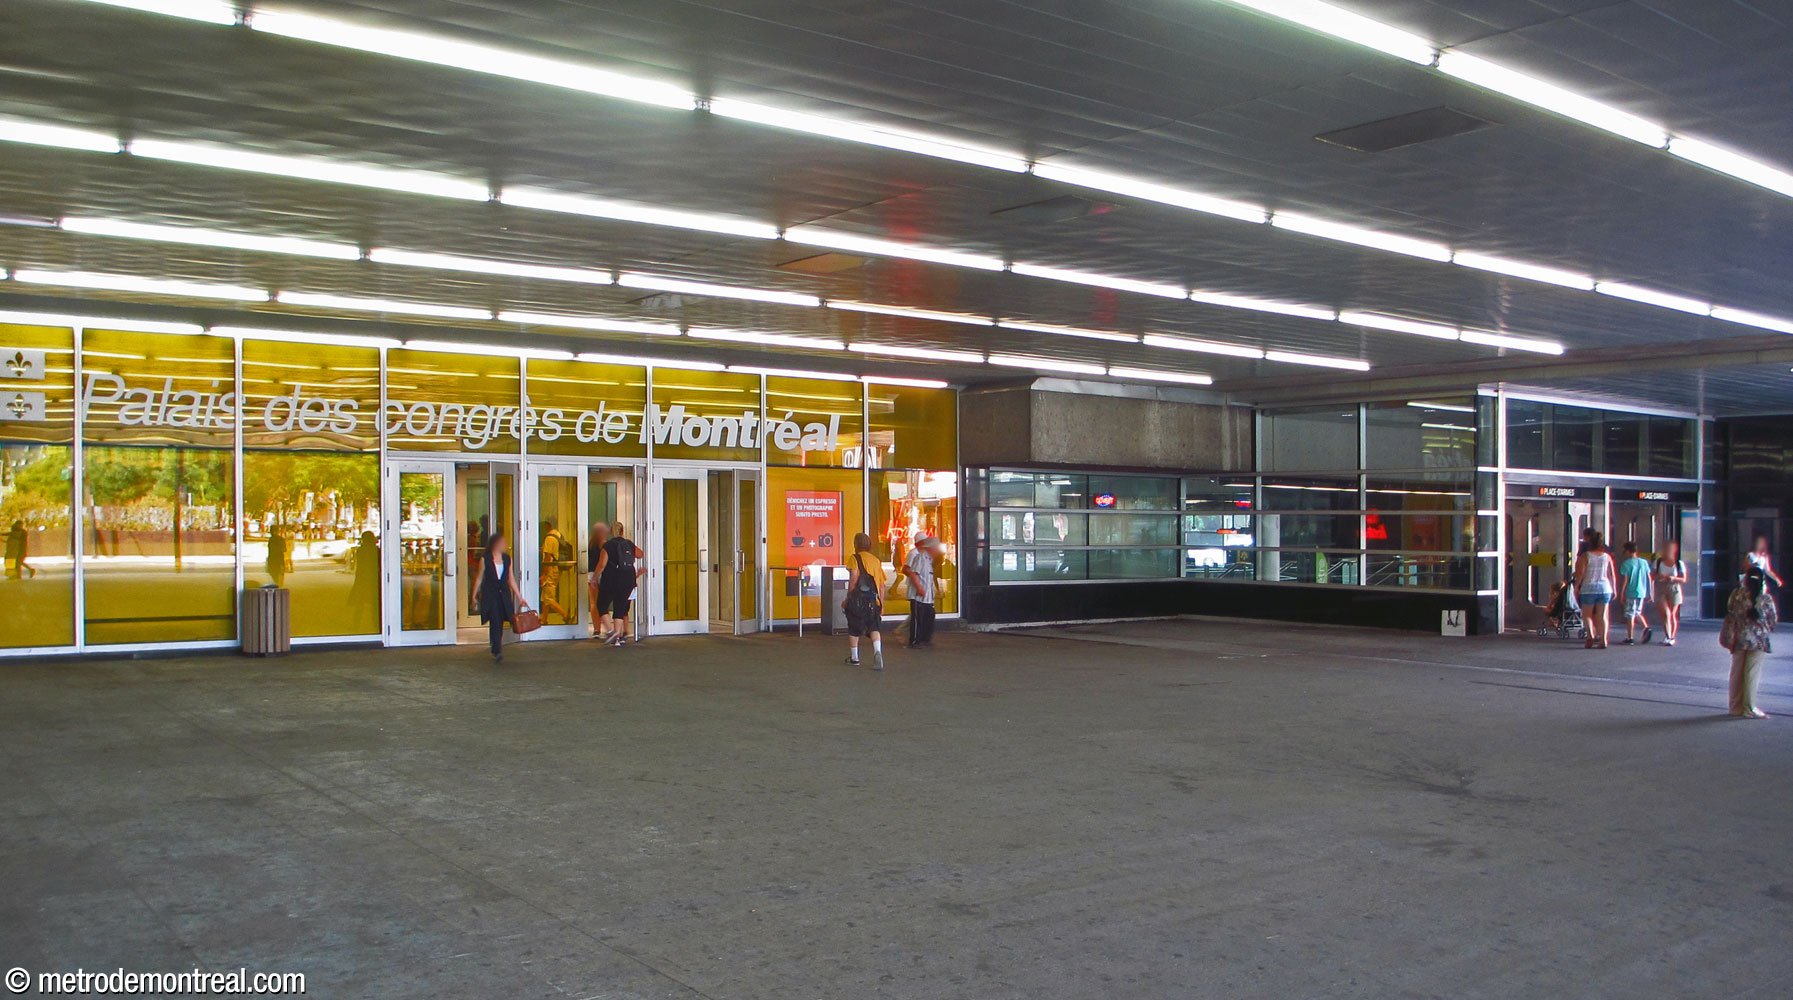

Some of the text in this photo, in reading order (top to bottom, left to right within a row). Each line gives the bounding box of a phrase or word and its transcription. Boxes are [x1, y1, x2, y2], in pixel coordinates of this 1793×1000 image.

[82, 373, 841, 452] Palais des congrès de Montréal
